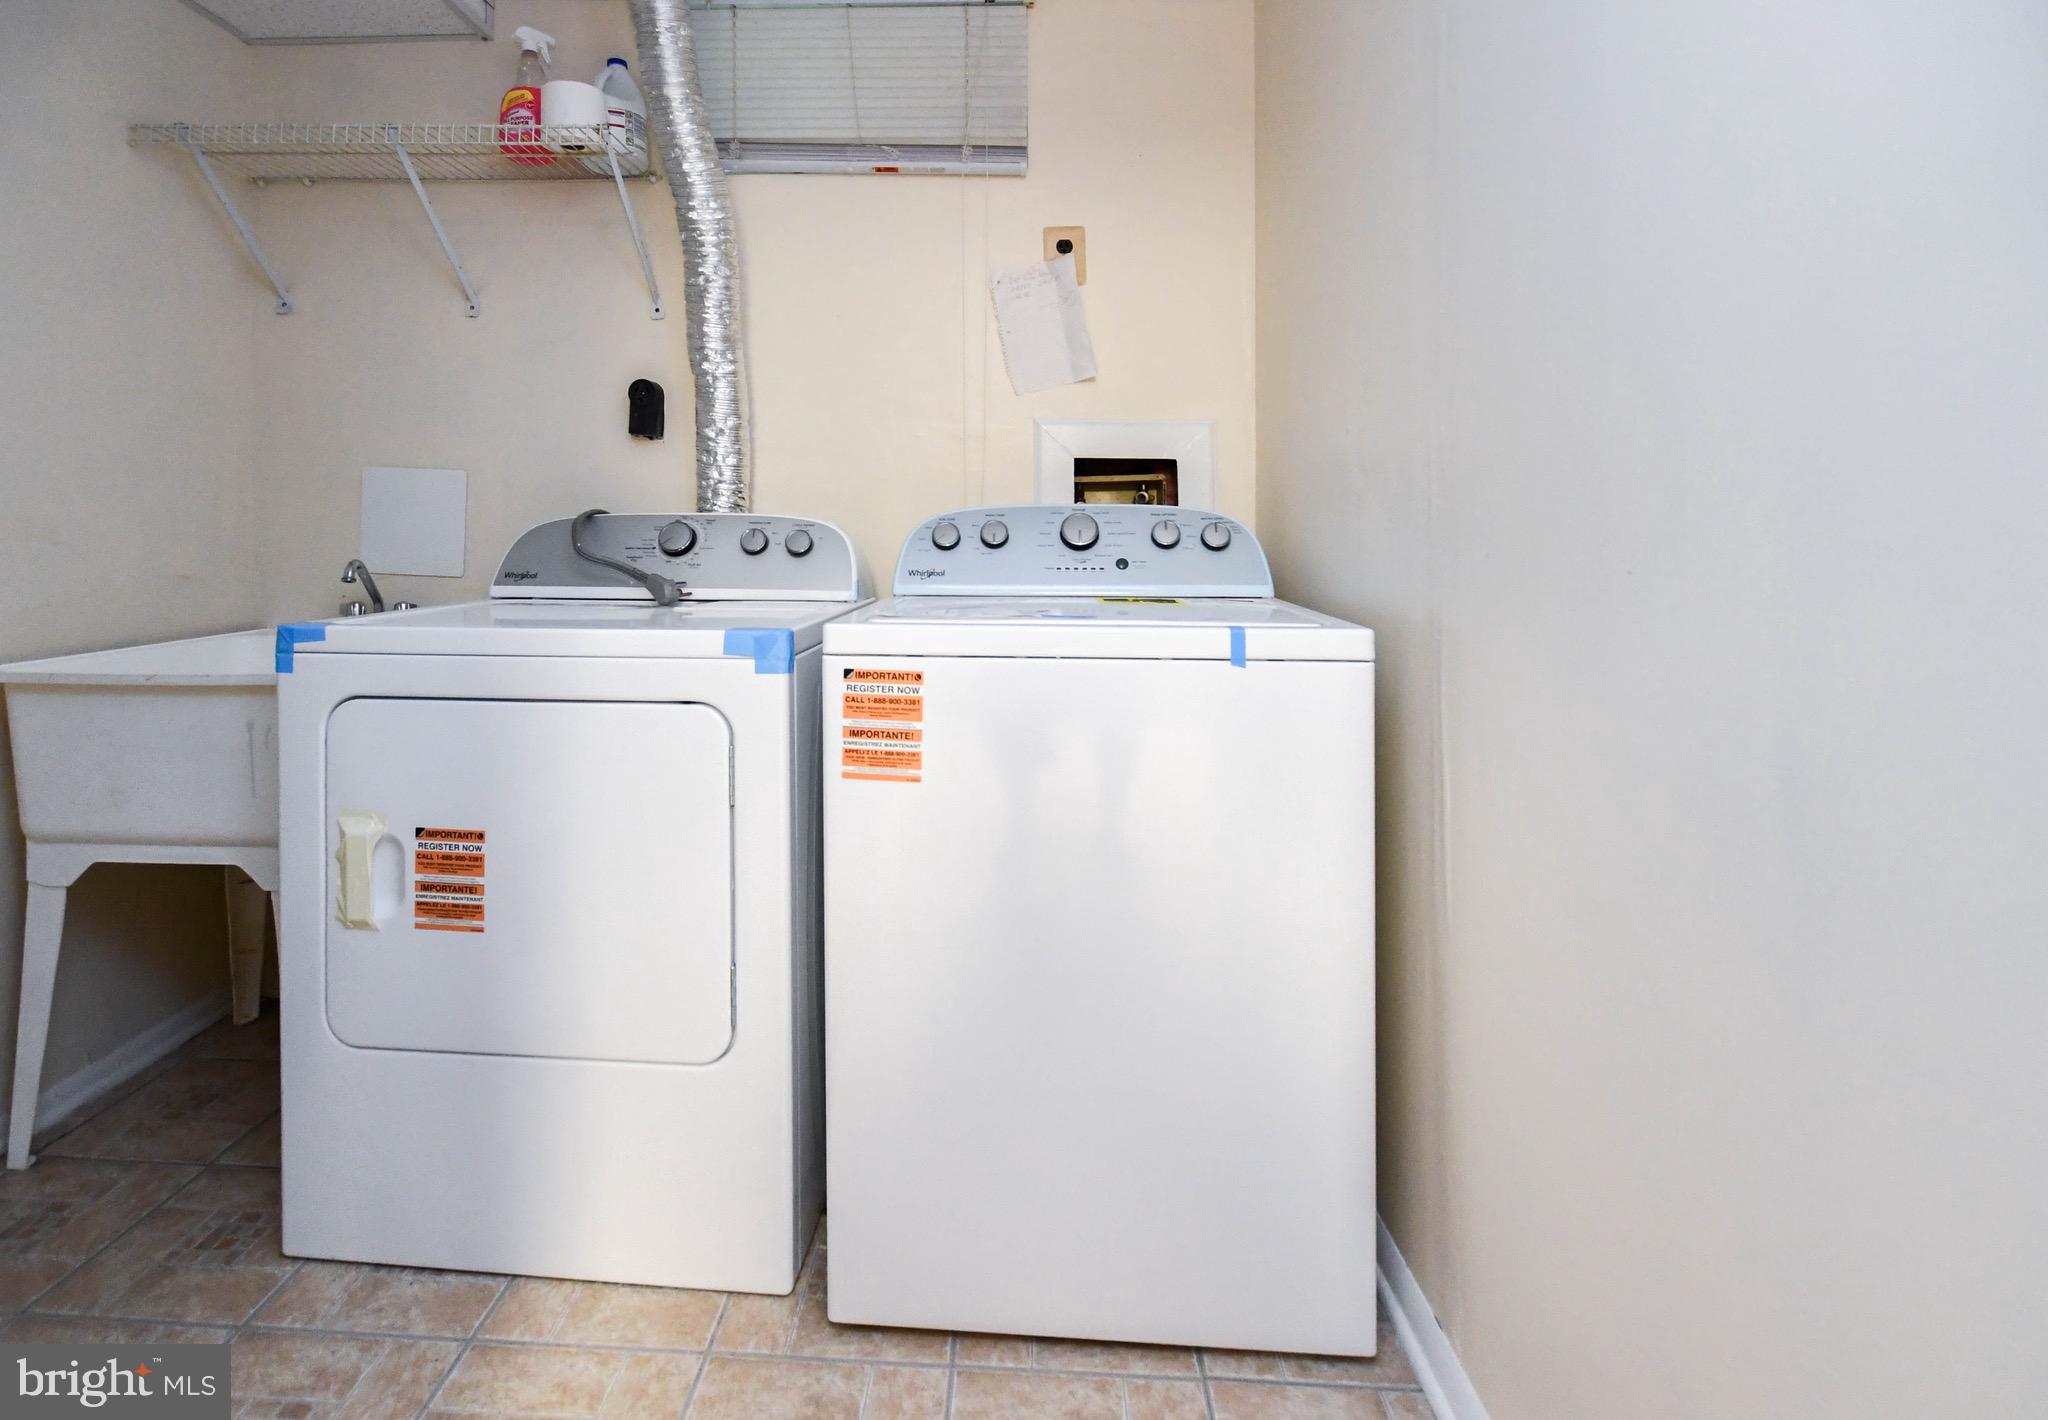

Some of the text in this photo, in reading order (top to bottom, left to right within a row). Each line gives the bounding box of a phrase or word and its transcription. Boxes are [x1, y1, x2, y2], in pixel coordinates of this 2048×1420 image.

[504, 570, 538, 582] Whirlpool
[908, 568, 946, 580] Whirlpool
[855, 671, 914, 680] IMPORTANT!
[846, 684, 921, 695] REGISTER NOW
[845, 696, 920, 706] CALL 1-888-900-3381
[849, 729, 914, 740] IMPORTANTE!
[425, 830, 477, 839] IMPORTANT!
[417, 842, 483, 852] REGISTER NOW
[420, 884, 478, 894] IMPORTANTE!
